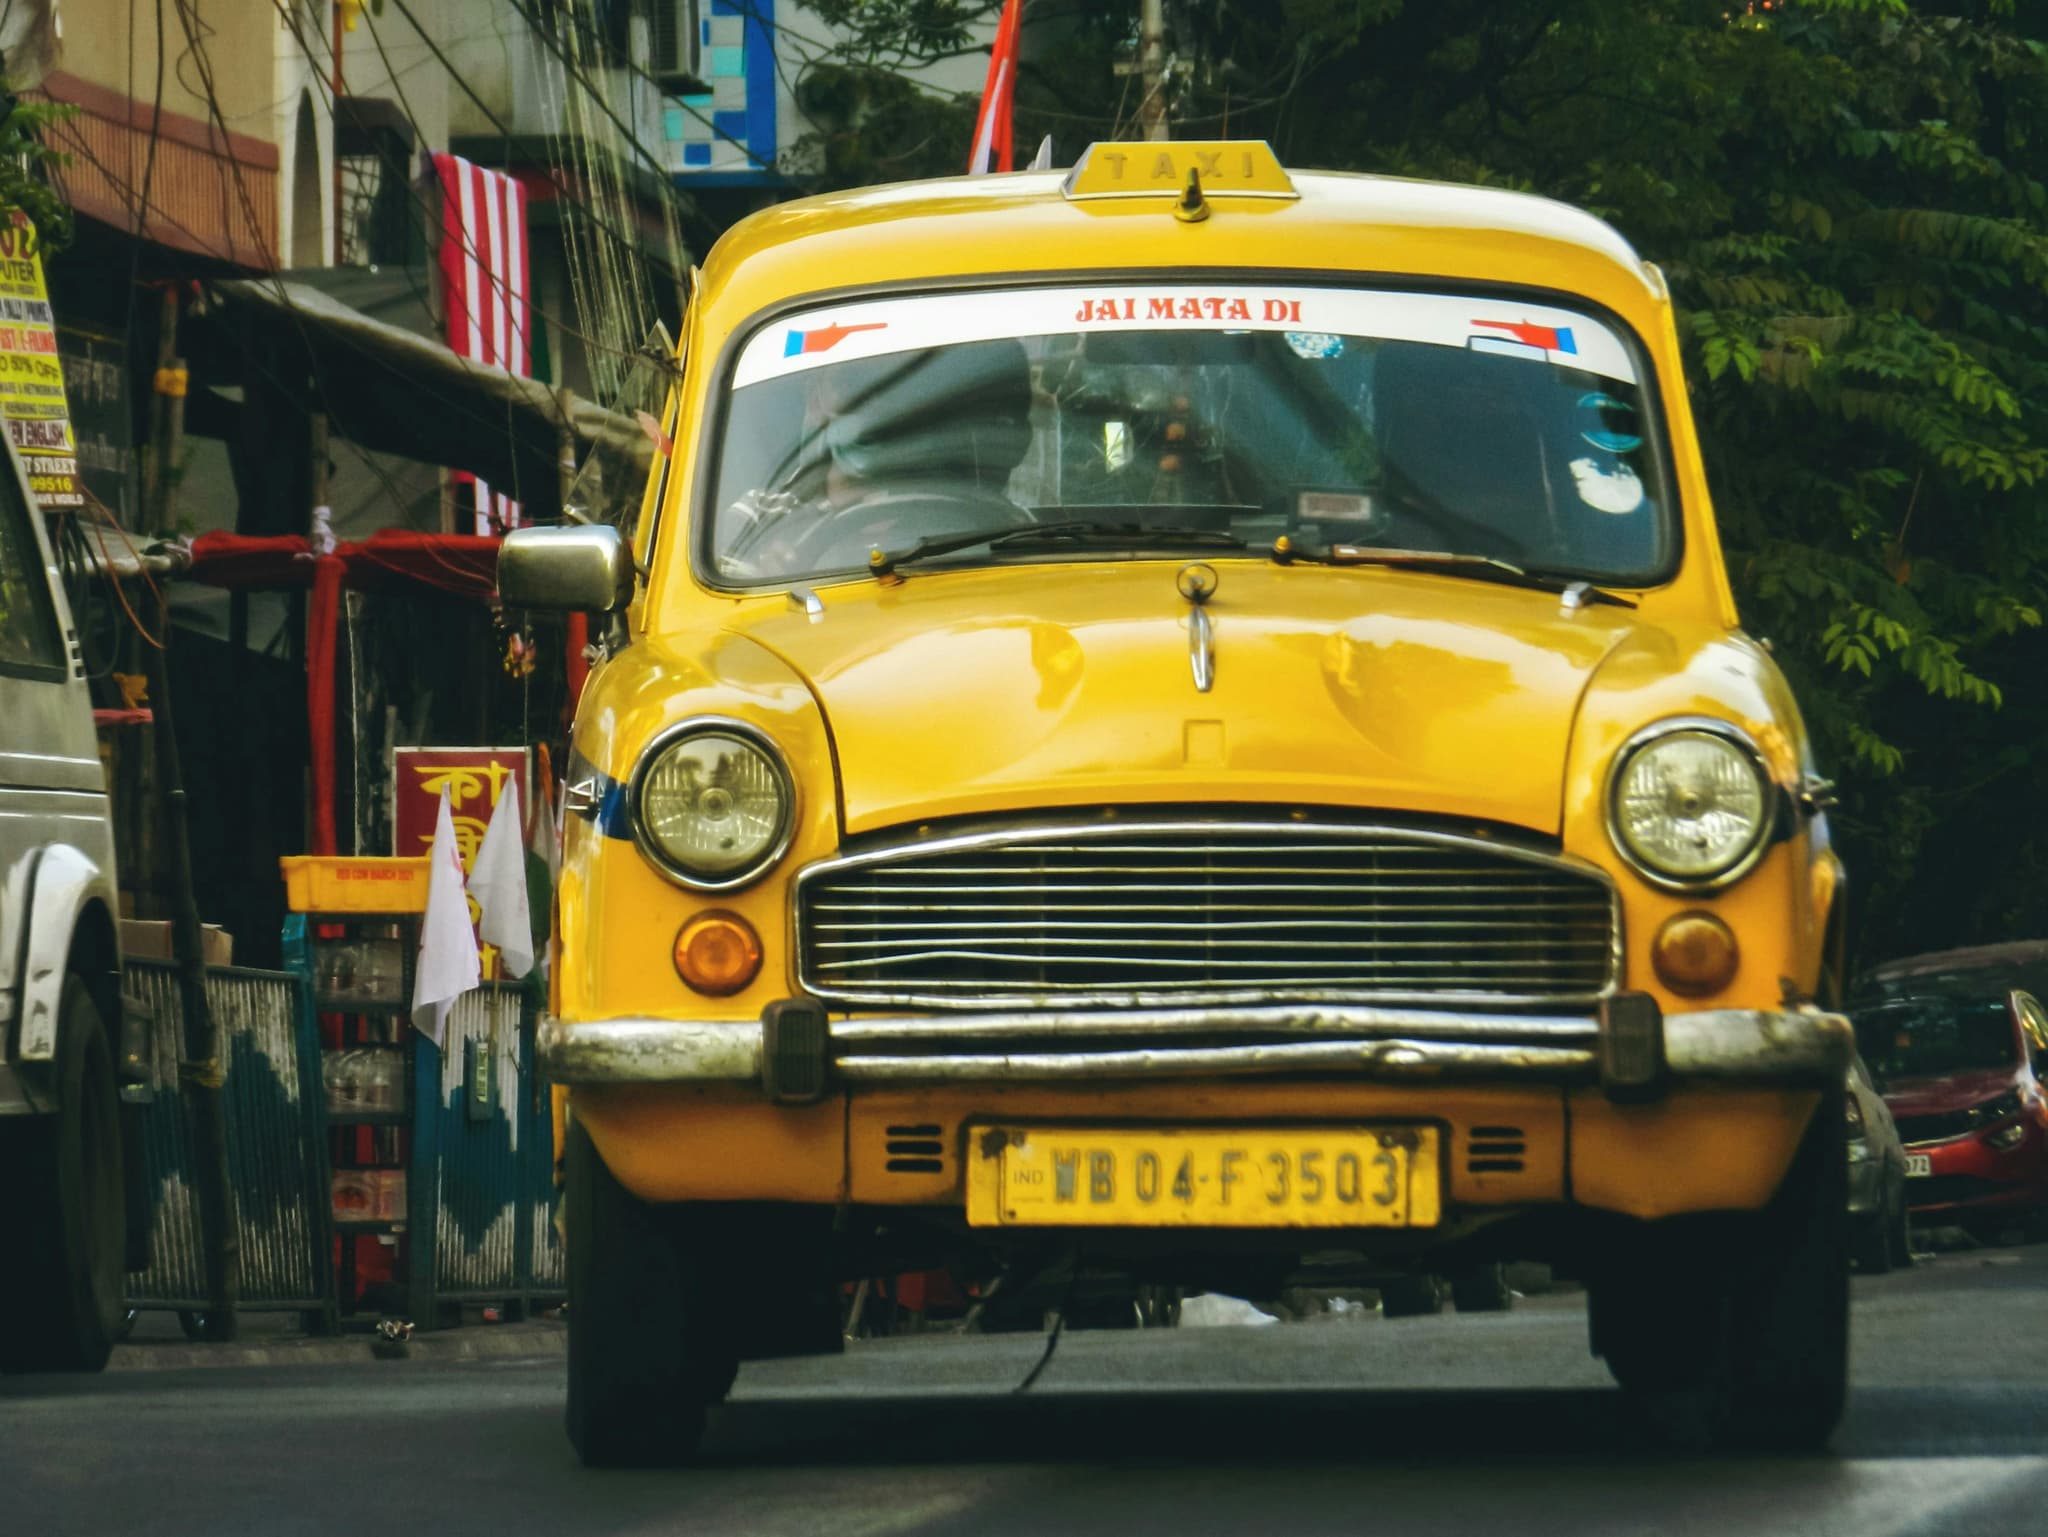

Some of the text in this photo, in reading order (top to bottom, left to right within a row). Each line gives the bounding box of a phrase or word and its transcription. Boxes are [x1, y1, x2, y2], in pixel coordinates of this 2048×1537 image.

[1104, 151, 1254, 181] TAXI
[1075, 297, 1302, 323] JAI MATA DI
[26, 421, 65, 447] ENGLISH
[34, 458, 77, 475] STREET
[1013, 1169, 1044, 1185] IND
[1053, 1150, 1116, 1203] WB
